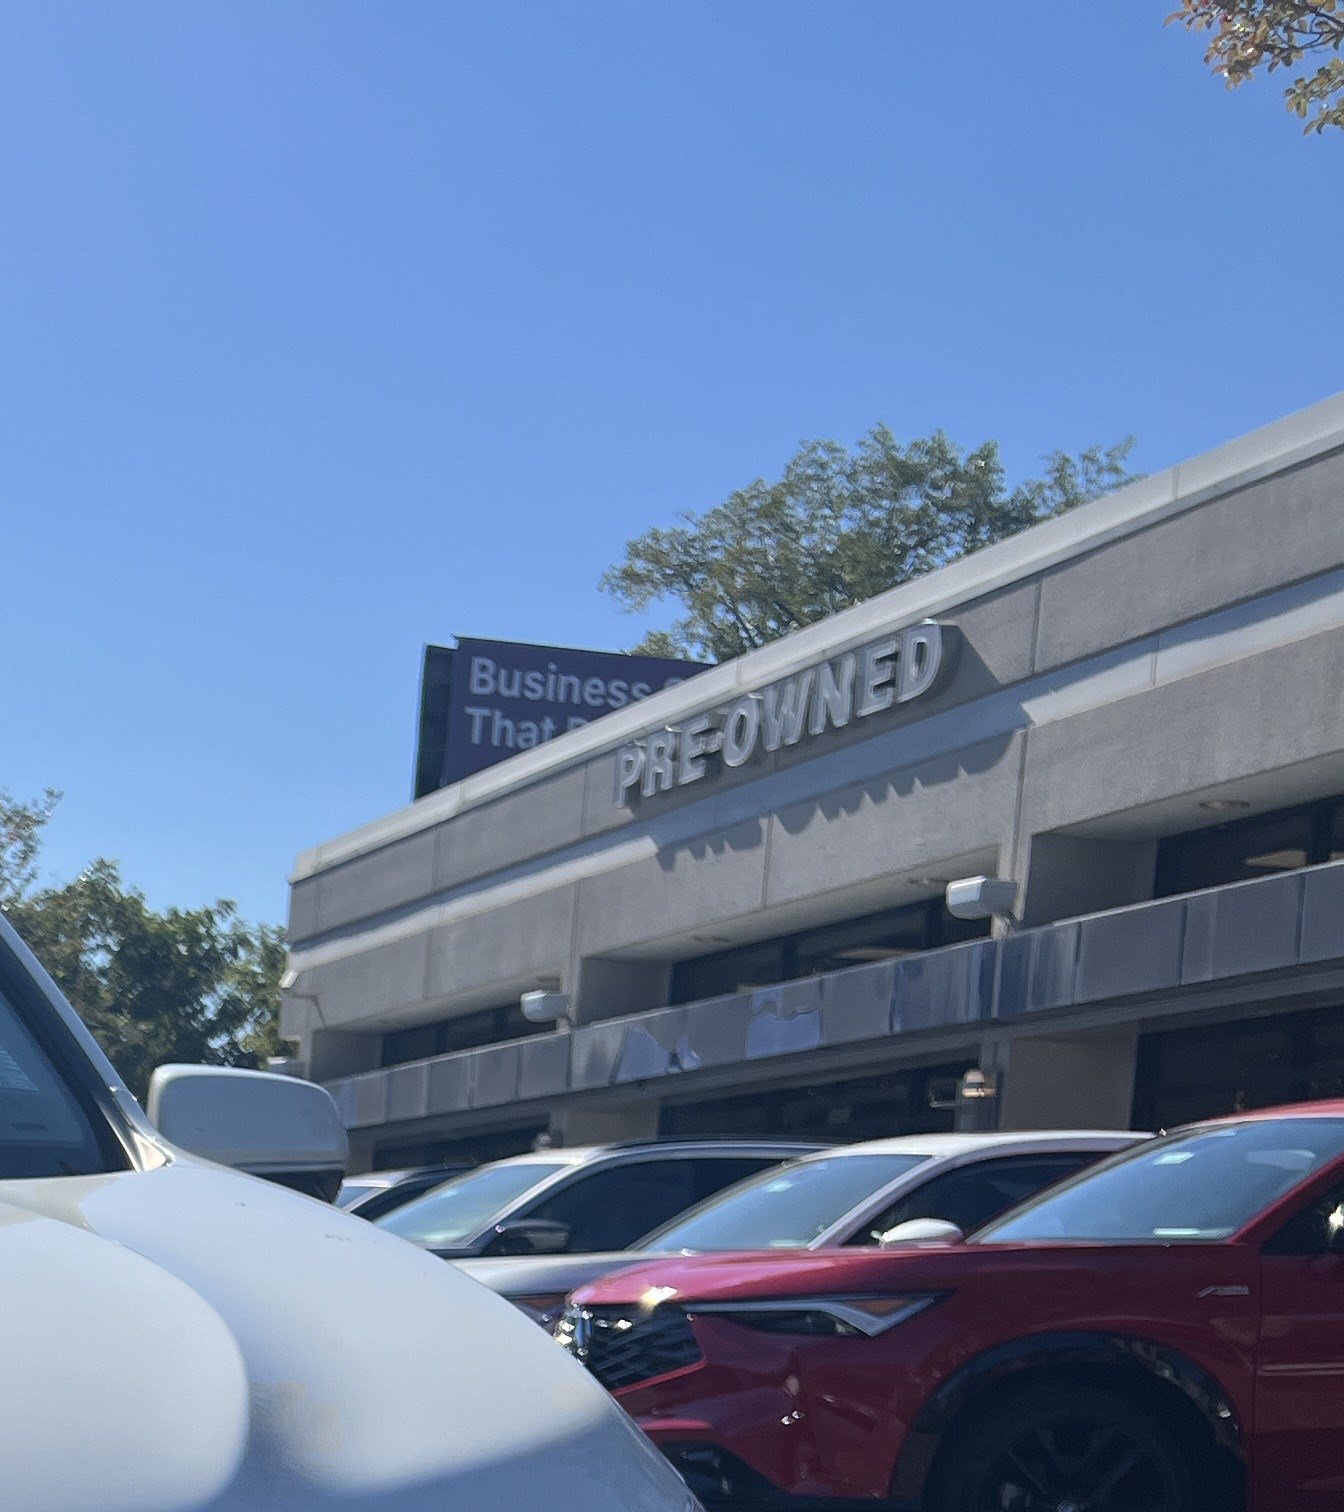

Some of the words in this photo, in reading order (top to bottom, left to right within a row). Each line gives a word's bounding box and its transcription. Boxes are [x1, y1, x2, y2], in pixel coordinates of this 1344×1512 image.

[470, 656, 652, 708] Business
[464, 706, 557, 749] That
[613, 618, 942, 808] PRE-OWNED
